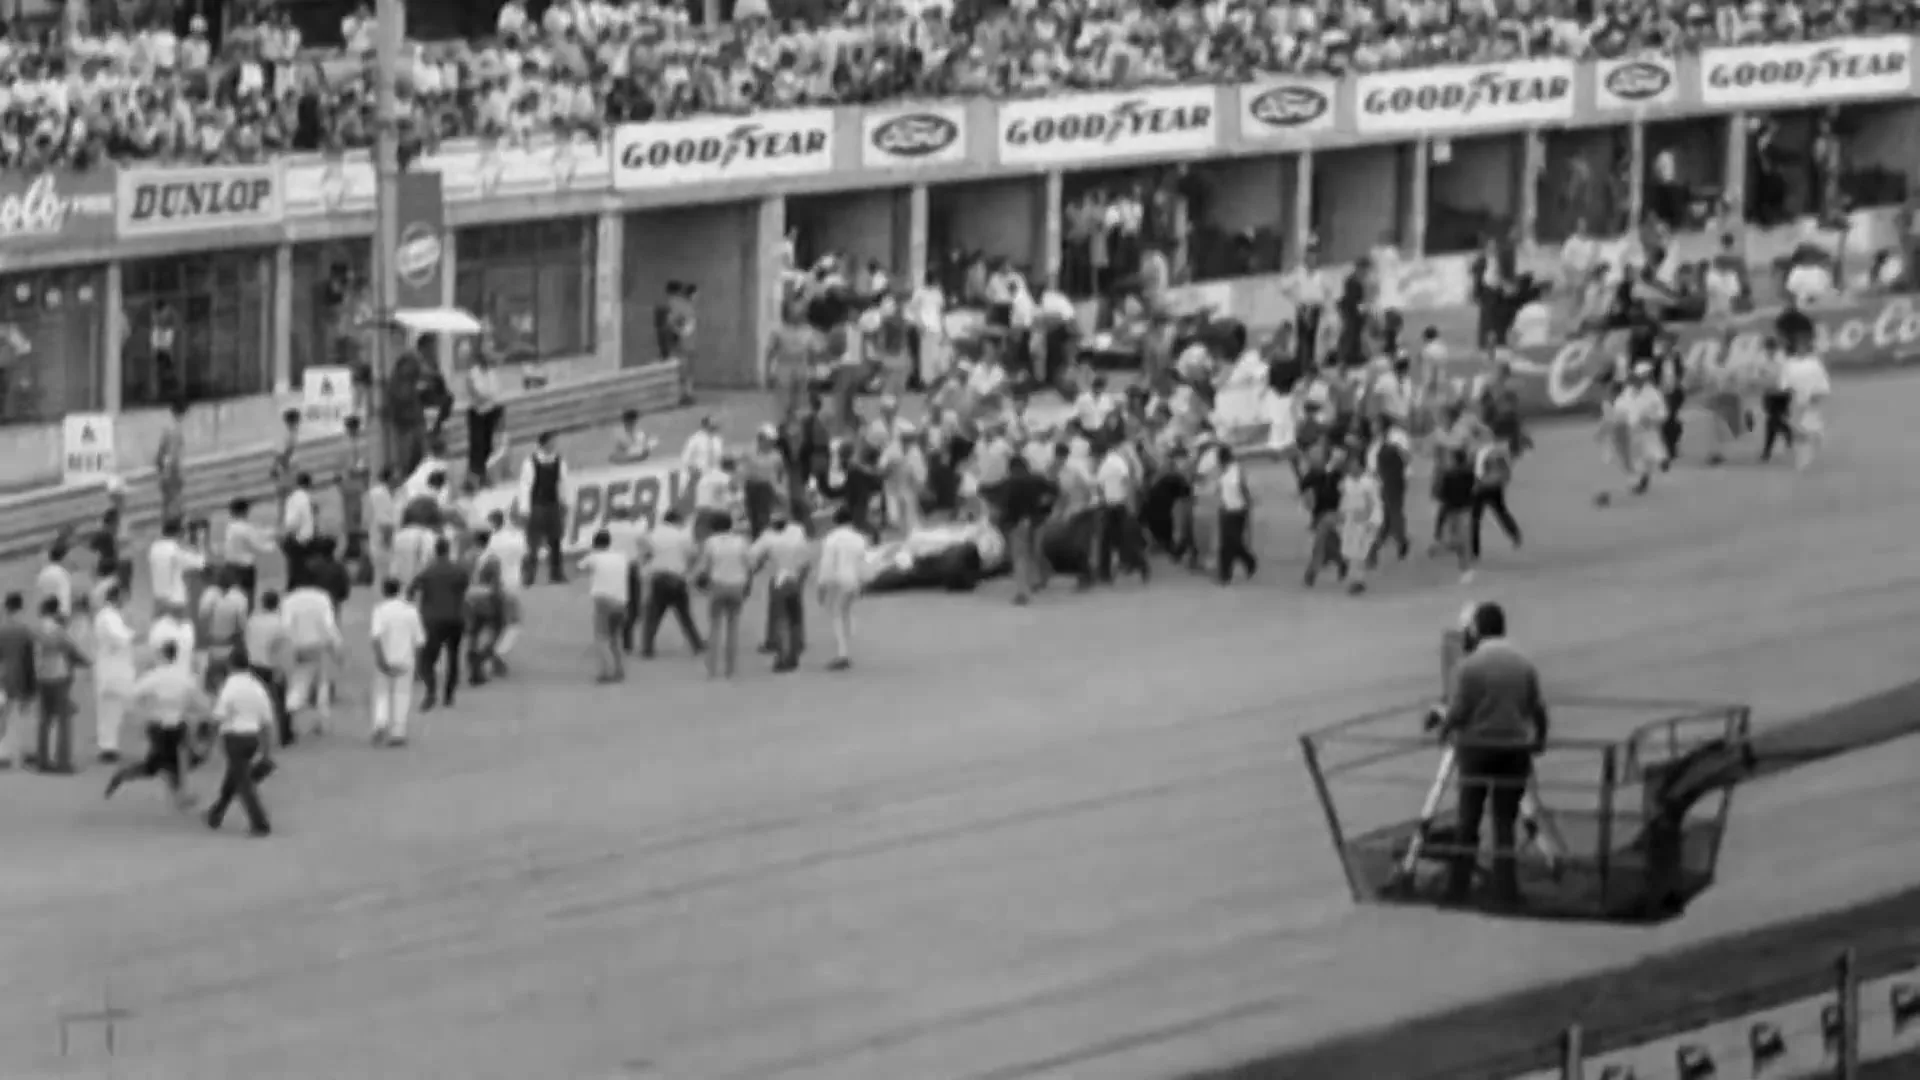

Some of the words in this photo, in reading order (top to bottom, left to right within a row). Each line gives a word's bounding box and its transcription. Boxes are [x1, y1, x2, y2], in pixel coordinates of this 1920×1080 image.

[1363, 72, 1569, 115] GOODYEAR
[1004, 101, 1212, 146] GOODYEAR
[620, 122, 828, 171] GOODYEAR
[130, 178, 272, 221] DUNLOP
